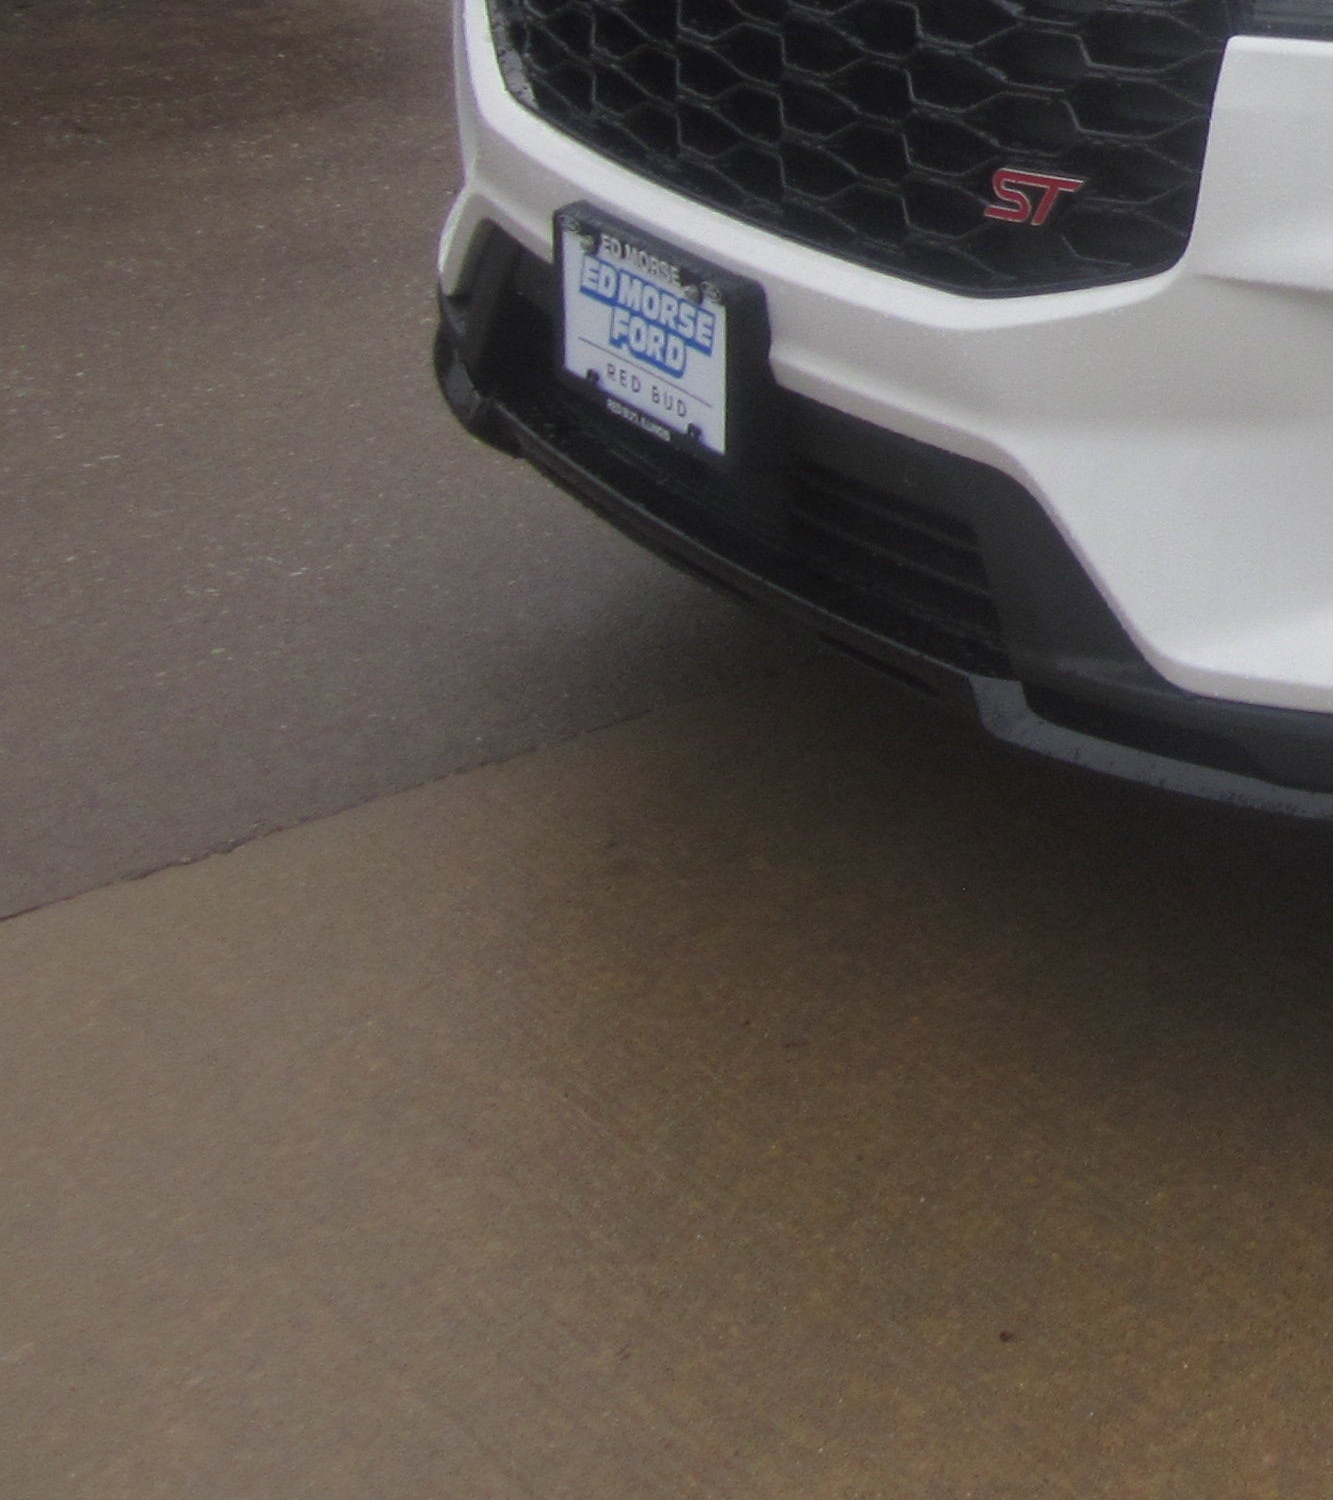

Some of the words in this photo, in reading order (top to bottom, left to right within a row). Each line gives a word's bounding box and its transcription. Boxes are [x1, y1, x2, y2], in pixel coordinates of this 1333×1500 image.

[984, 167, 1085, 226] ST
[601, 234, 622, 256] ED
[623, 243, 682, 287] MORSE
[580, 255, 620, 305] ED
[619, 269, 715, 357] MORSE
[610, 307, 687, 378] FORD
[606, 363, 642, 393] RED
[652, 386, 687, 418] BUD
